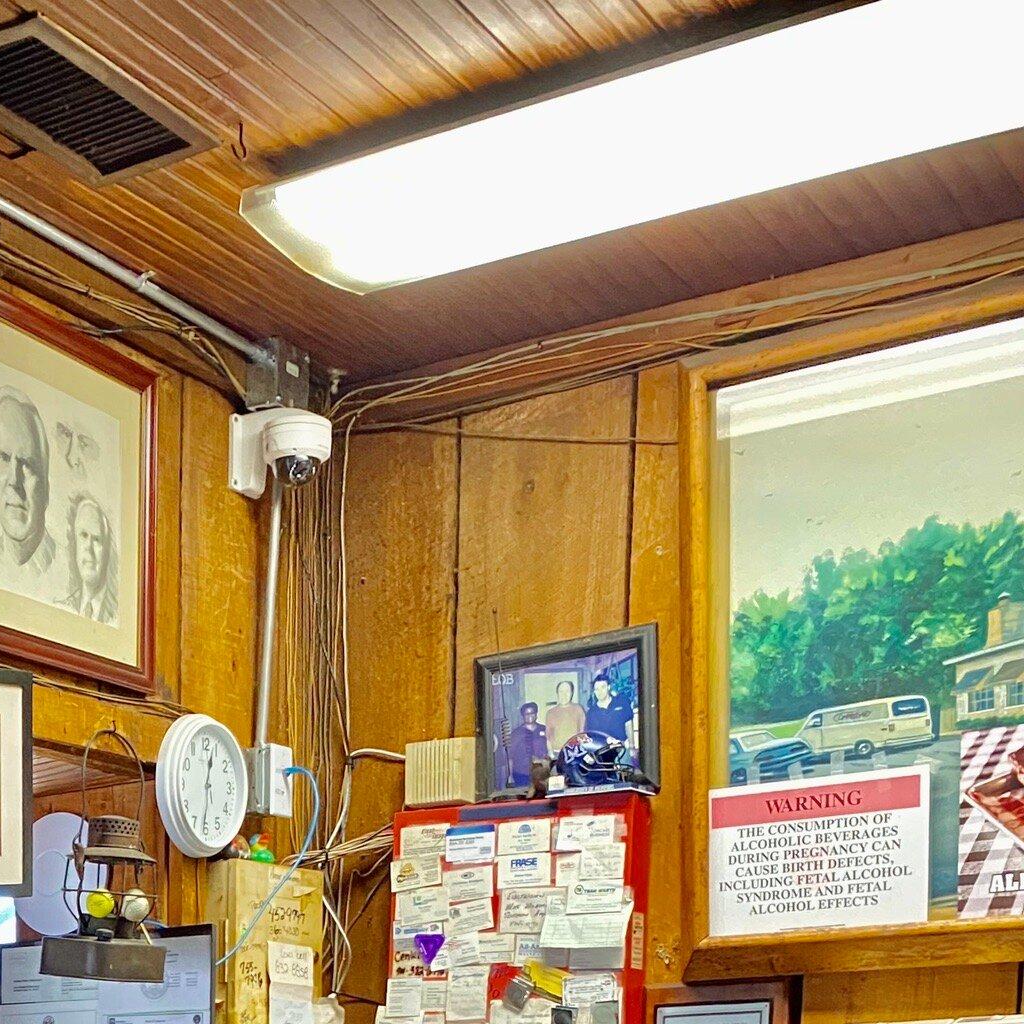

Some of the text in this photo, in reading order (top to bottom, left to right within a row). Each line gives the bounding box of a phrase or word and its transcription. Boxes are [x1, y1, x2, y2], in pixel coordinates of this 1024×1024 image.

[201, 737, 210, 751] 12
[765, 790, 863, 815] WARNING
[737, 812, 893, 839] THE CONSUMPTION OF
[731, 825, 899, 852] ALCOHOLIC BEVERAGES
[728, 838, 902, 866] DURING PREGNANCY CAN
[735, 853, 895, 877] CAUSE BIRTH DEFECTS,
[719, 865, 912, 892] INCLUDING FETAL ALCOHOL
[989, 871, 1024, 893] AL
[736, 880, 892, 904] SYNDROME AND FETAL
[749, 895, 878, 916] ALCOHOL EFFECTS
